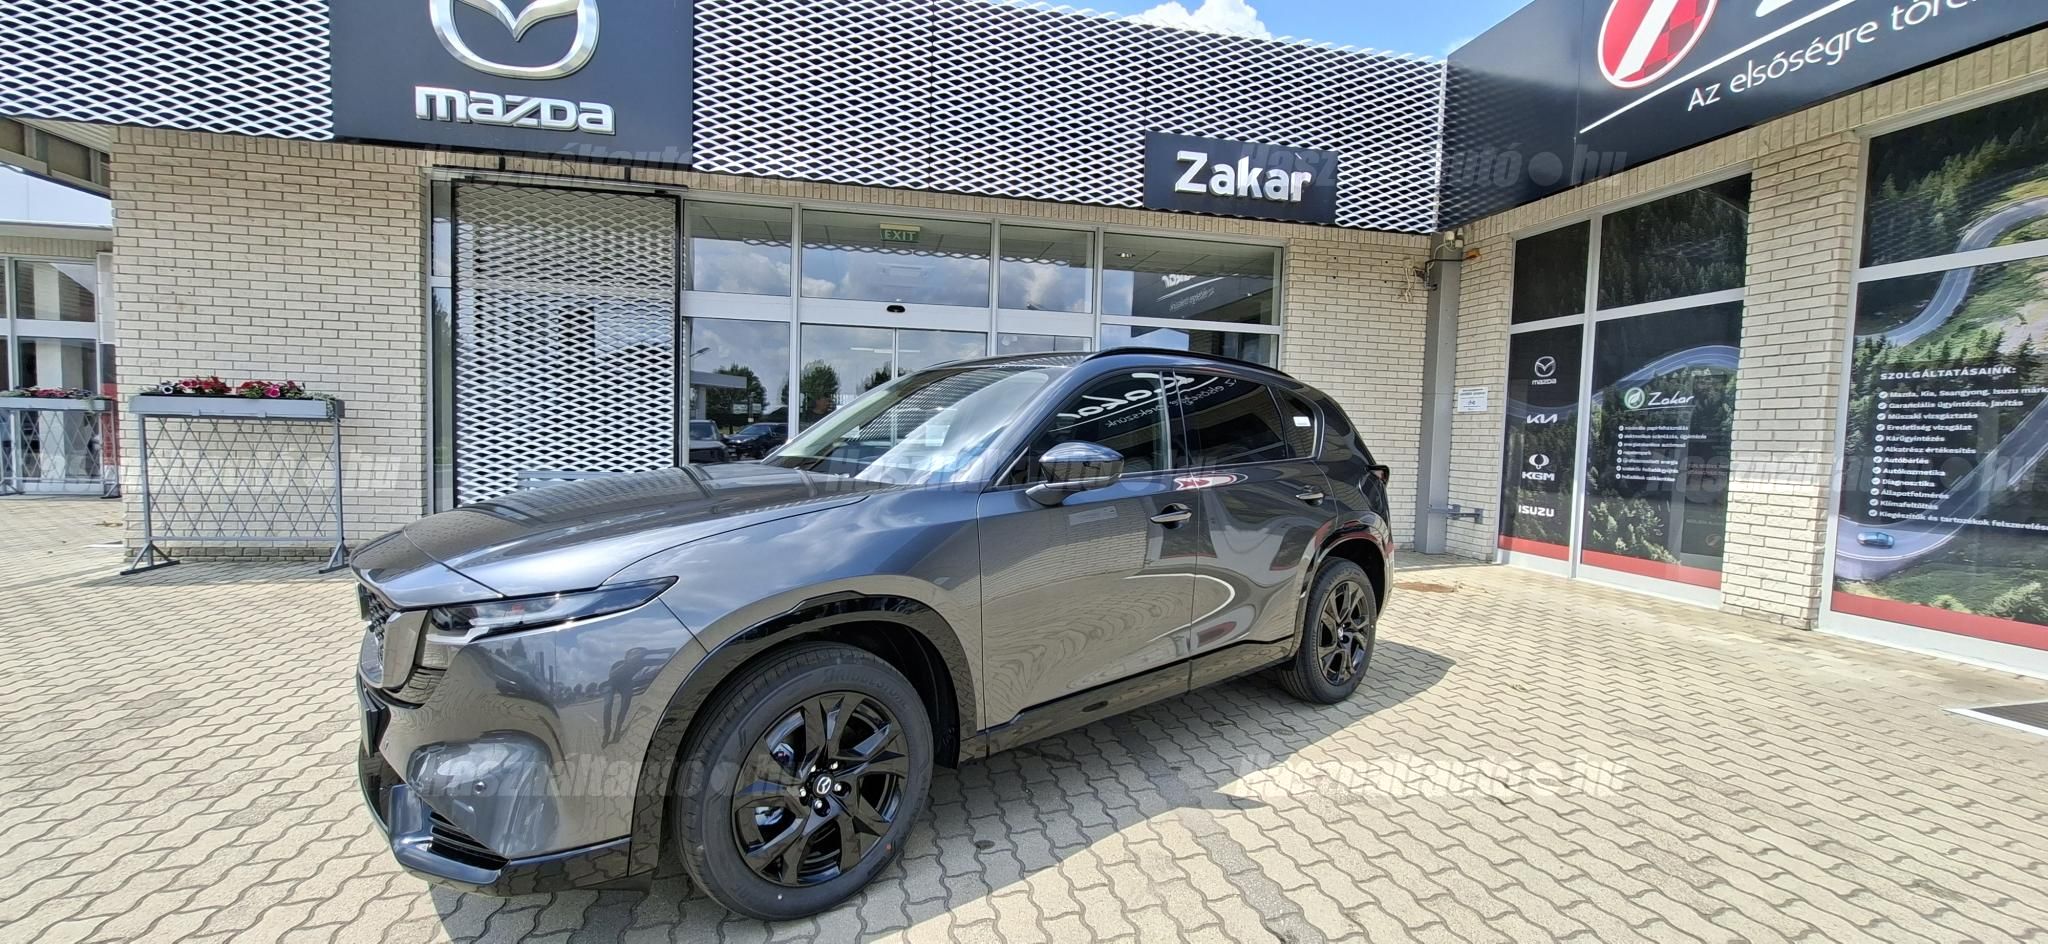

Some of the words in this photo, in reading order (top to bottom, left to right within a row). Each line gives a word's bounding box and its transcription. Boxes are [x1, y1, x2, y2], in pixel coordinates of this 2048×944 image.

[1687, 82, 1722, 112] Az
[1729, 21, 1879, 93] elsőségre
[1891, 0, 1977, 31] tör
[1175, 150, 1313, 203] Zakar
[884, 230, 917, 241] EXIT
[1880, 366, 2017, 380] SZOLGÁLTATÁSAINK:
[1648, 390, 1694, 406] Zakar
[1522, 471, 1555, 481] KGM
[1518, 504, 1555, 517] ISUZU
